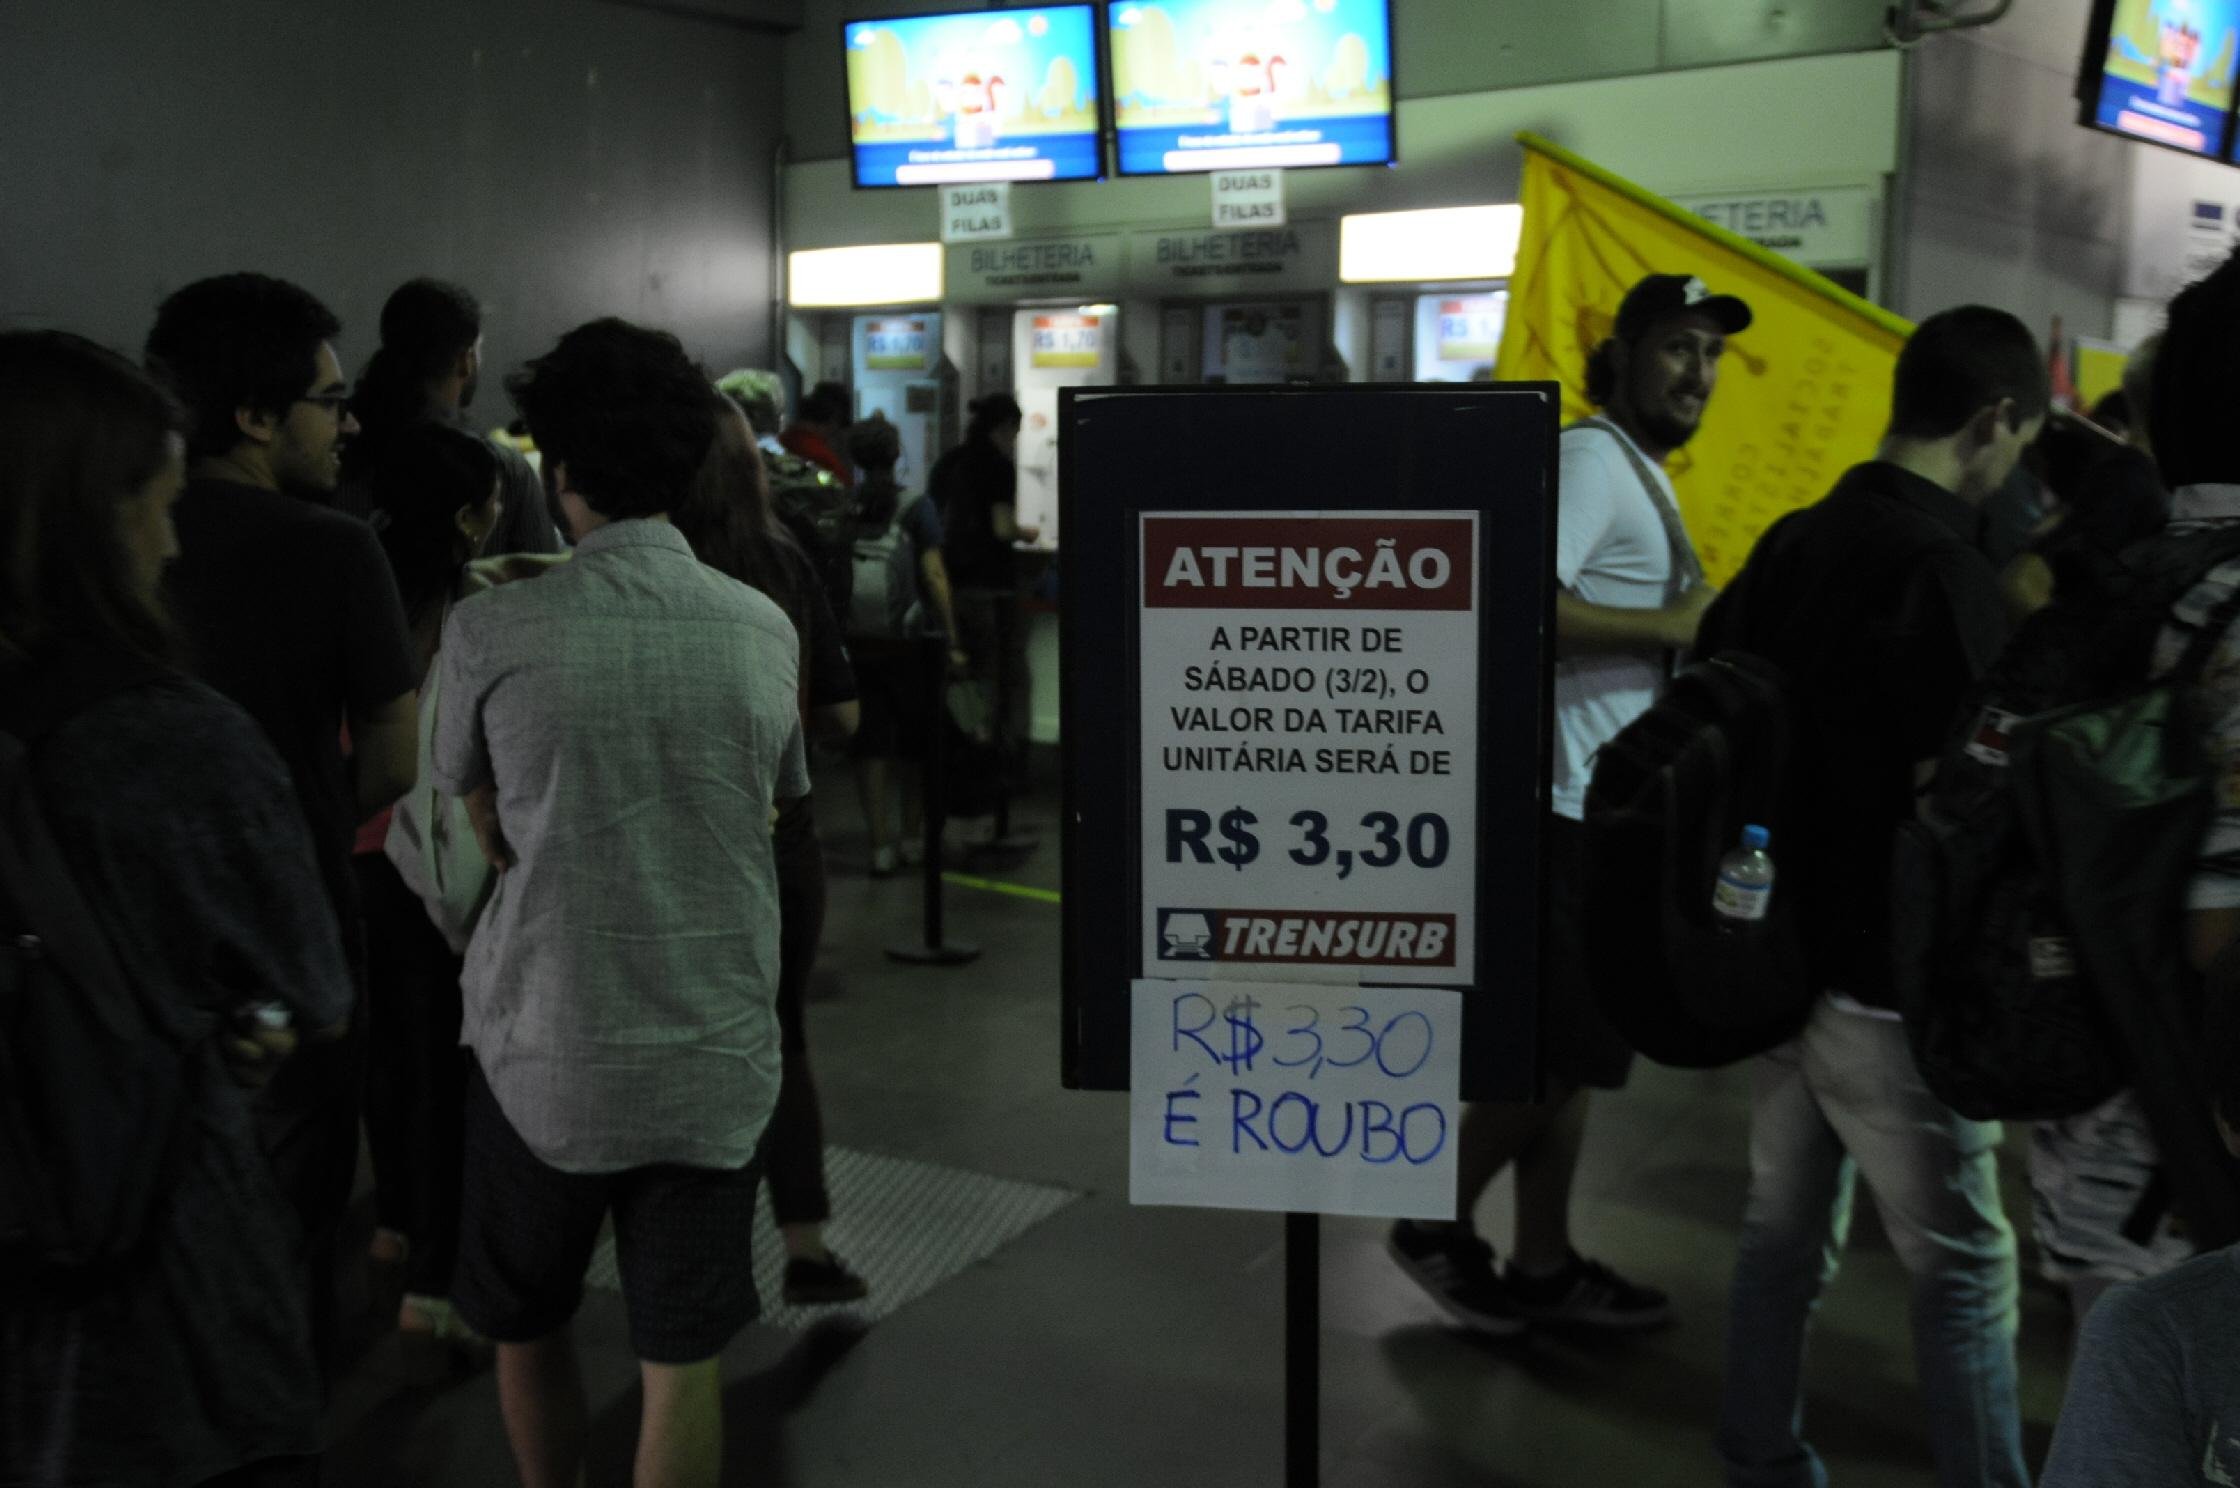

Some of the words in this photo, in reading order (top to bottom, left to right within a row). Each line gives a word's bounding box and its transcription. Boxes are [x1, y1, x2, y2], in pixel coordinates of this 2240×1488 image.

[951, 189, 999, 205] DUAS
[1218, 175, 1273, 191] DUAS
[952, 216, 1002, 233] FILAS
[1219, 203, 1275, 219] FILAS
[1700, 198, 1827, 232] ETERIA
[970, 243, 1095, 273] BILHETERIA
[1156, 231, 1299, 263] BILHETERIA
[1163, 538, 1451, 599] ATENÇÃO
[1210, 627, 1231, 651] A
[1241, 627, 1351, 652] PARTIR
[1362, 628, 1403, 653] DE
[1184, 660, 1316, 693] SÁBADO
[1326, 668, 1396, 700] (3/2),
[1406, 669, 1429, 694] O
[1171, 707, 1273, 732] VALOR
[1285, 708, 1327, 734] DA
[1336, 709, 1444, 735] TARIFA
[1163, 741, 1306, 774] UNITÁRIA
[1315, 743, 1399, 775] SERÁ
[1410, 750, 1451, 776] DE
[1165, 806, 1260, 871] R$
[1288, 810, 1450, 880] 3,30
[1222, 917, 1451, 960] TRENSURB
[1173, 993, 1264, 1076] R$
[1273, 1004, 1434, 1079] 3,30
[1164, 1073, 1201, 1147] É
[1231, 1088, 1447, 1166] ROUBO
